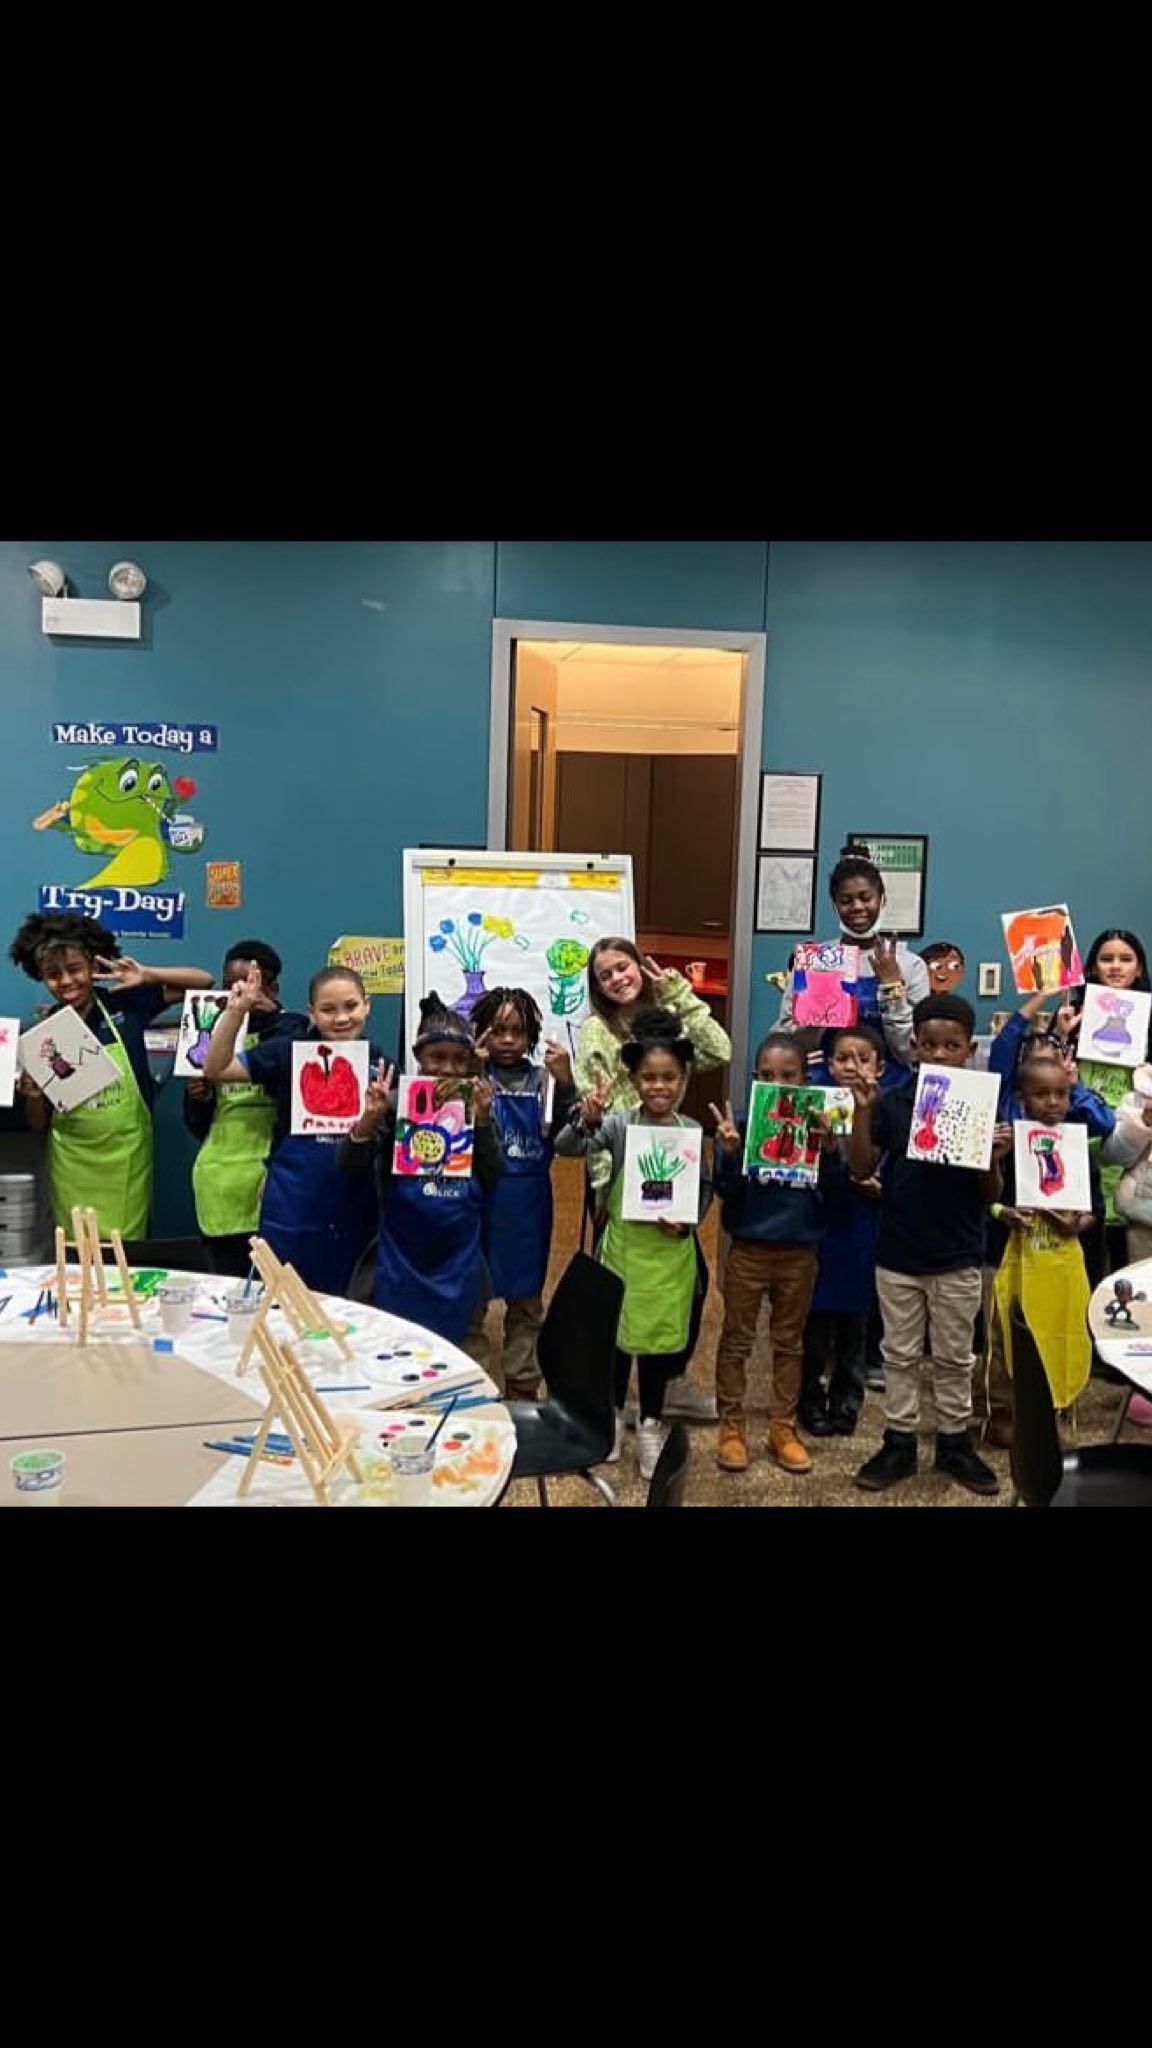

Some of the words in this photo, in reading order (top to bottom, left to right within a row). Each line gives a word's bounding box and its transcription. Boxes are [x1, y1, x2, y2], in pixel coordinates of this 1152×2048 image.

[55, 723, 116, 745] Make
[122, 724, 193, 753] Today
[199, 730, 212, 745] a
[41, 885, 185, 922] Try-Day!
[343, 943, 389, 968] BRAVE
